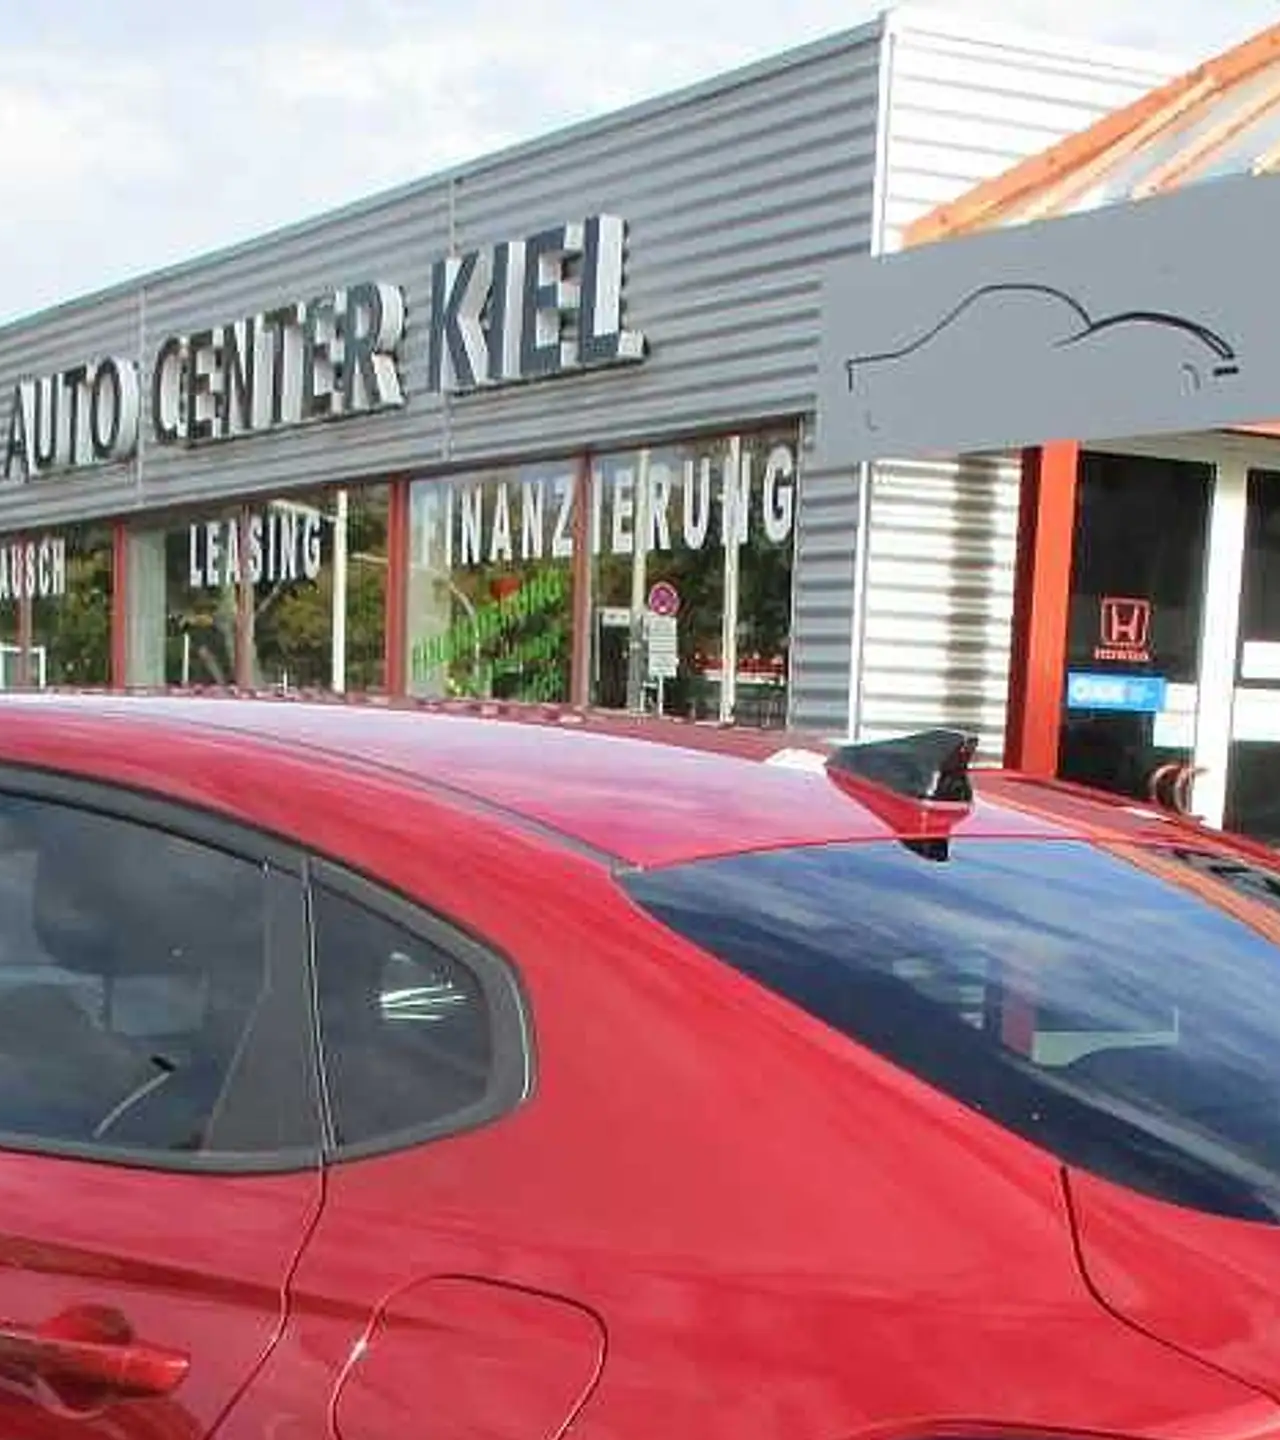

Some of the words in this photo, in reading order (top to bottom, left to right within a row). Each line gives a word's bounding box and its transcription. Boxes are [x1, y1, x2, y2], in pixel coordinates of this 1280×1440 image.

[5, 354, 140, 483] AUTO
[152, 282, 406, 448] CENTER
[428, 213, 646, 396] KIEL
[189, 513, 322, 589] LEASING
[420, 445, 794, 566] FINANZIERUNG
